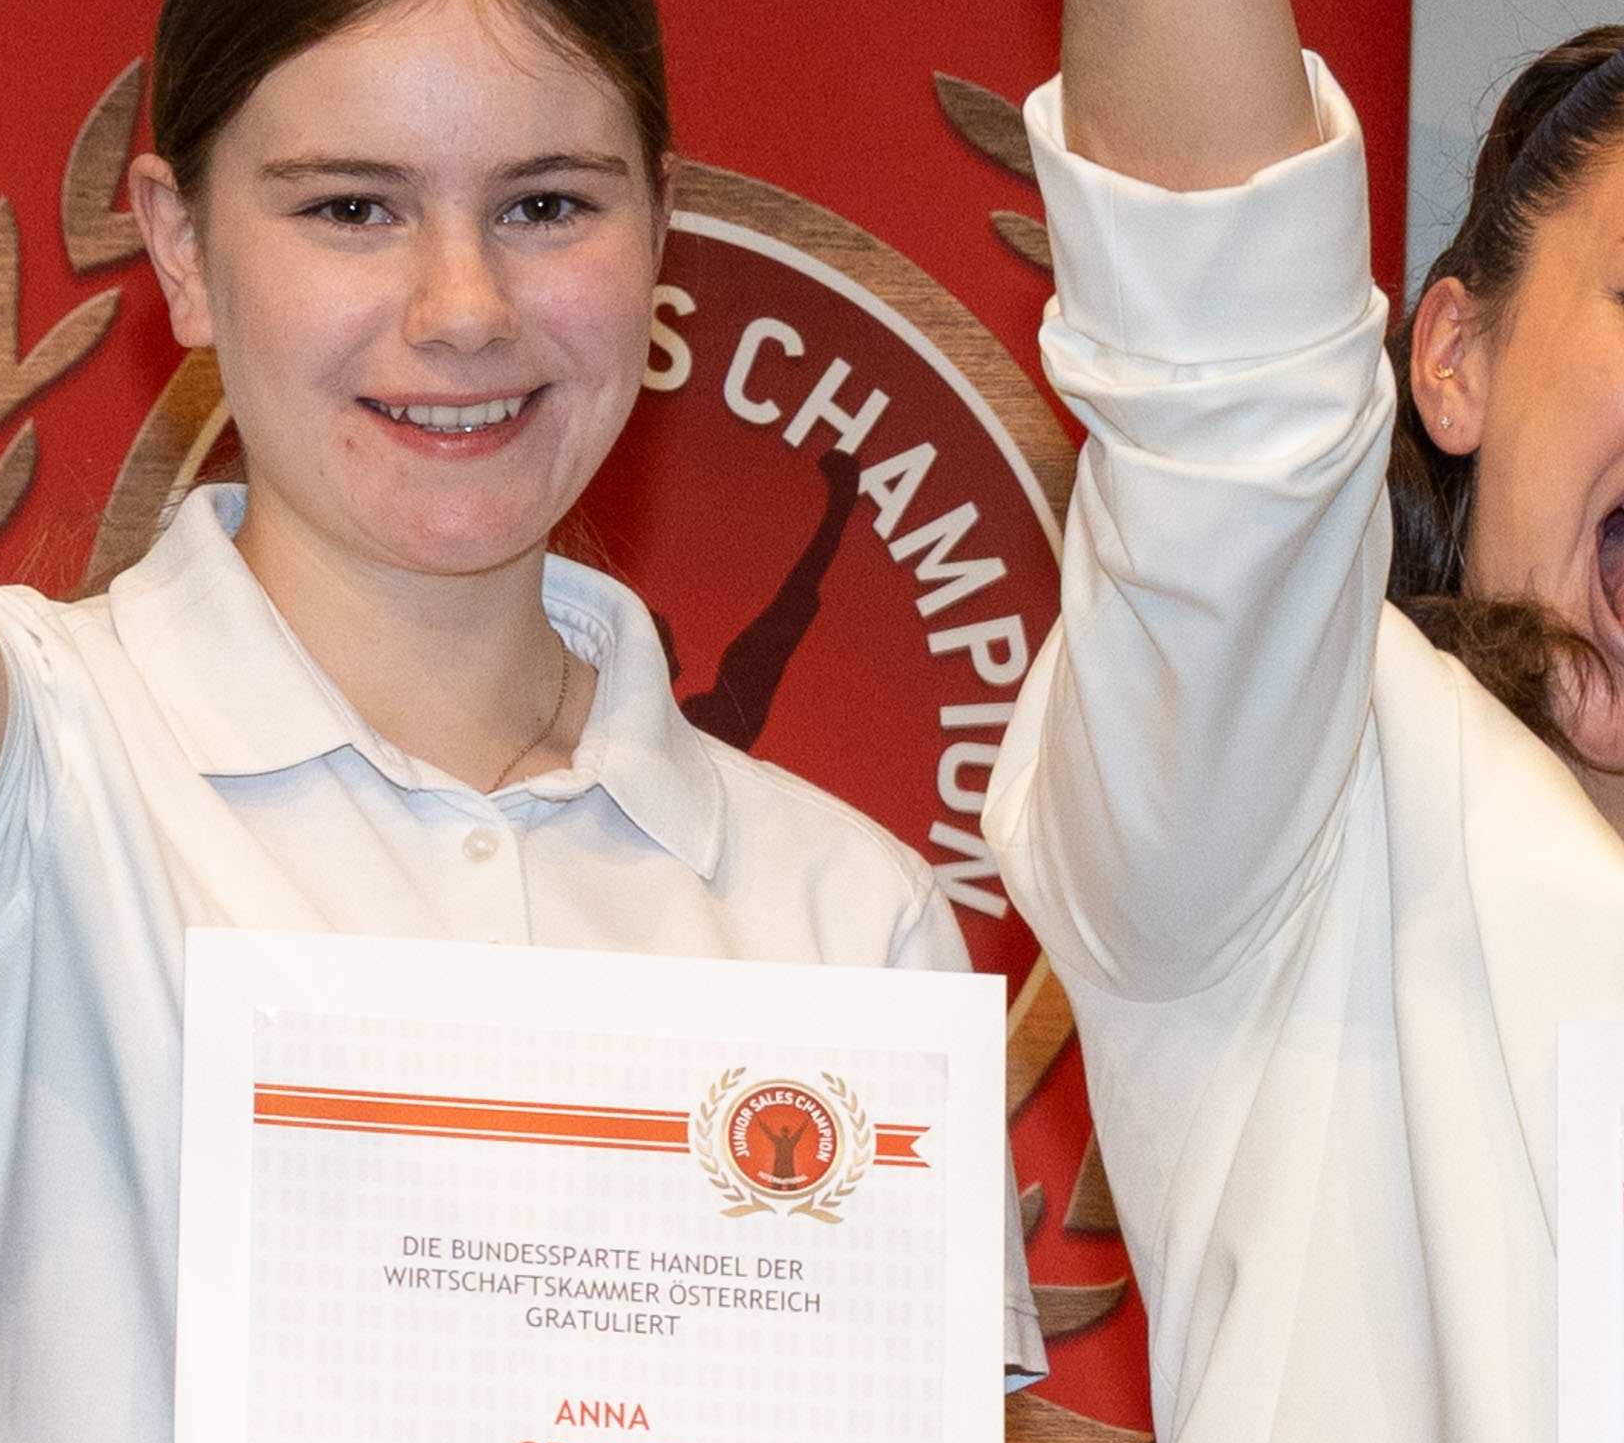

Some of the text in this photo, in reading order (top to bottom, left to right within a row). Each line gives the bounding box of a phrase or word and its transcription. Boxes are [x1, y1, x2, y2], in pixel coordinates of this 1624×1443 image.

[722, 316, 1029, 919] CHAMPION
[733, 1091, 833, 1163] JUNIOR SALES CHAMPION
[403, 1235, 803, 1281] DIE BUNDESSPARTE HANDEL DER
[384, 1266, 820, 1313] WIRTSCHAFTSKAMMER ÖSTERREICH
[526, 1306, 680, 1335] GRATULIERT
[555, 1399, 649, 1431] ANNA
